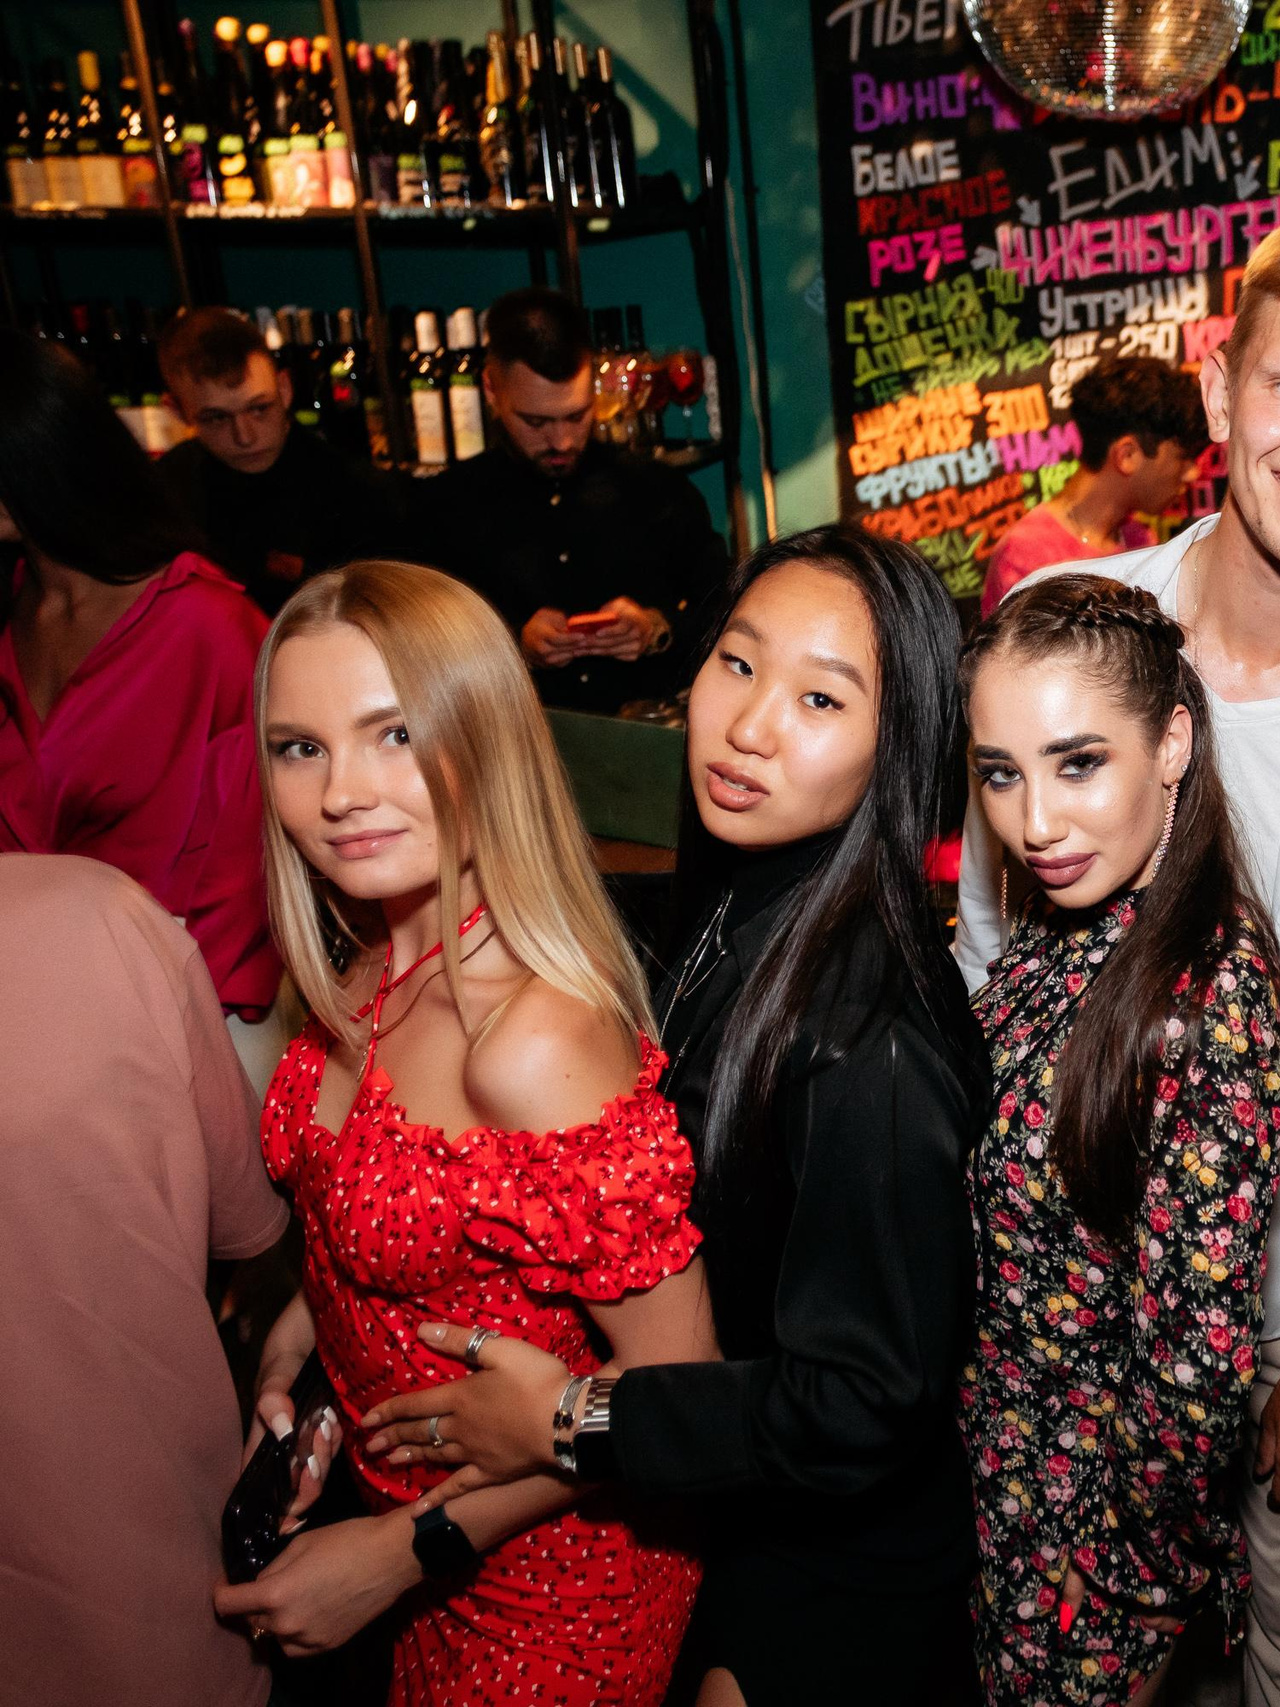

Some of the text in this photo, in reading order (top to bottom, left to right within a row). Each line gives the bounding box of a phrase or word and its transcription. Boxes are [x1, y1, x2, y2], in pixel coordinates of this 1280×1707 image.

[851, 139, 962, 197] БЕЛОЕ
[1048, 122, 1244, 220] ЕДИМ:
[857, 169, 1013, 237] КРАСНОЕ
[868, 222, 967, 288] РОЗЕ
[1038, 274, 1210, 338] УСТРИЦЫ
[982, 382, 1050, 440] 300
